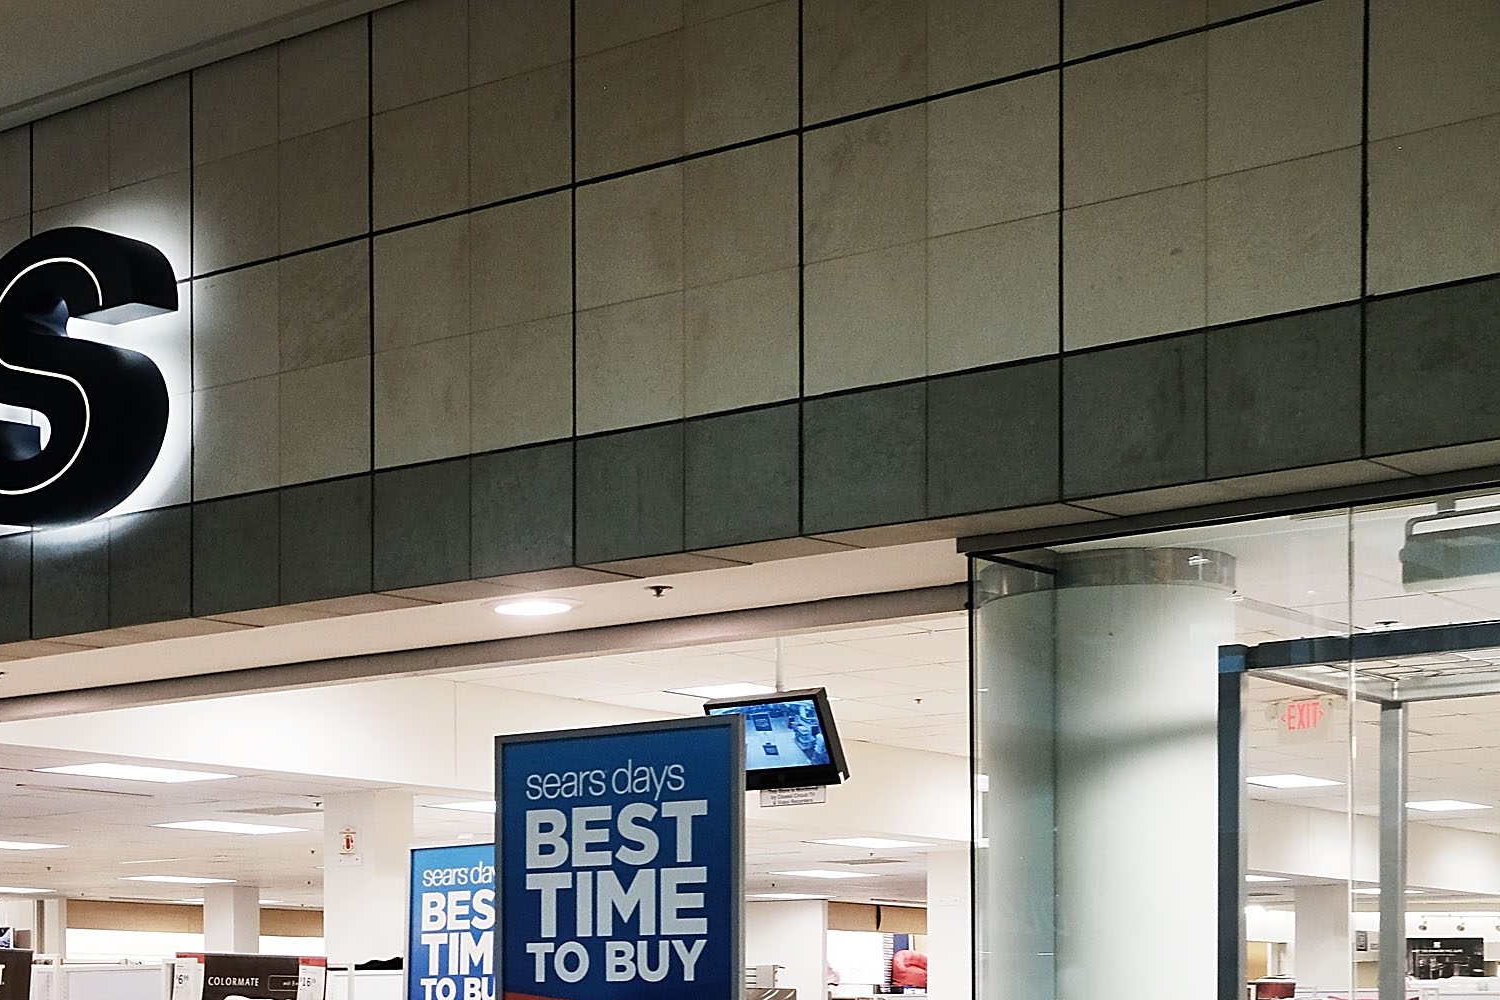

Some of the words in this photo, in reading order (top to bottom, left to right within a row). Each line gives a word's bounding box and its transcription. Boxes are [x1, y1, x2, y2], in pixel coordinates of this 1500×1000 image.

[1287, 701, 1320, 731] EXIT
[526, 770, 606, 801] sears
[612, 759, 685, 801] days
[526, 799, 708, 869] BEST
[422, 866, 468, 887] sears
[421, 889, 495, 931] BES
[526, 866, 708, 938] TIME
[420, 931, 494, 976] TIM
[526, 941, 589, 983] TO
[606, 939, 708, 983] BUY
[207, 976, 260, 987] COLORMATE
